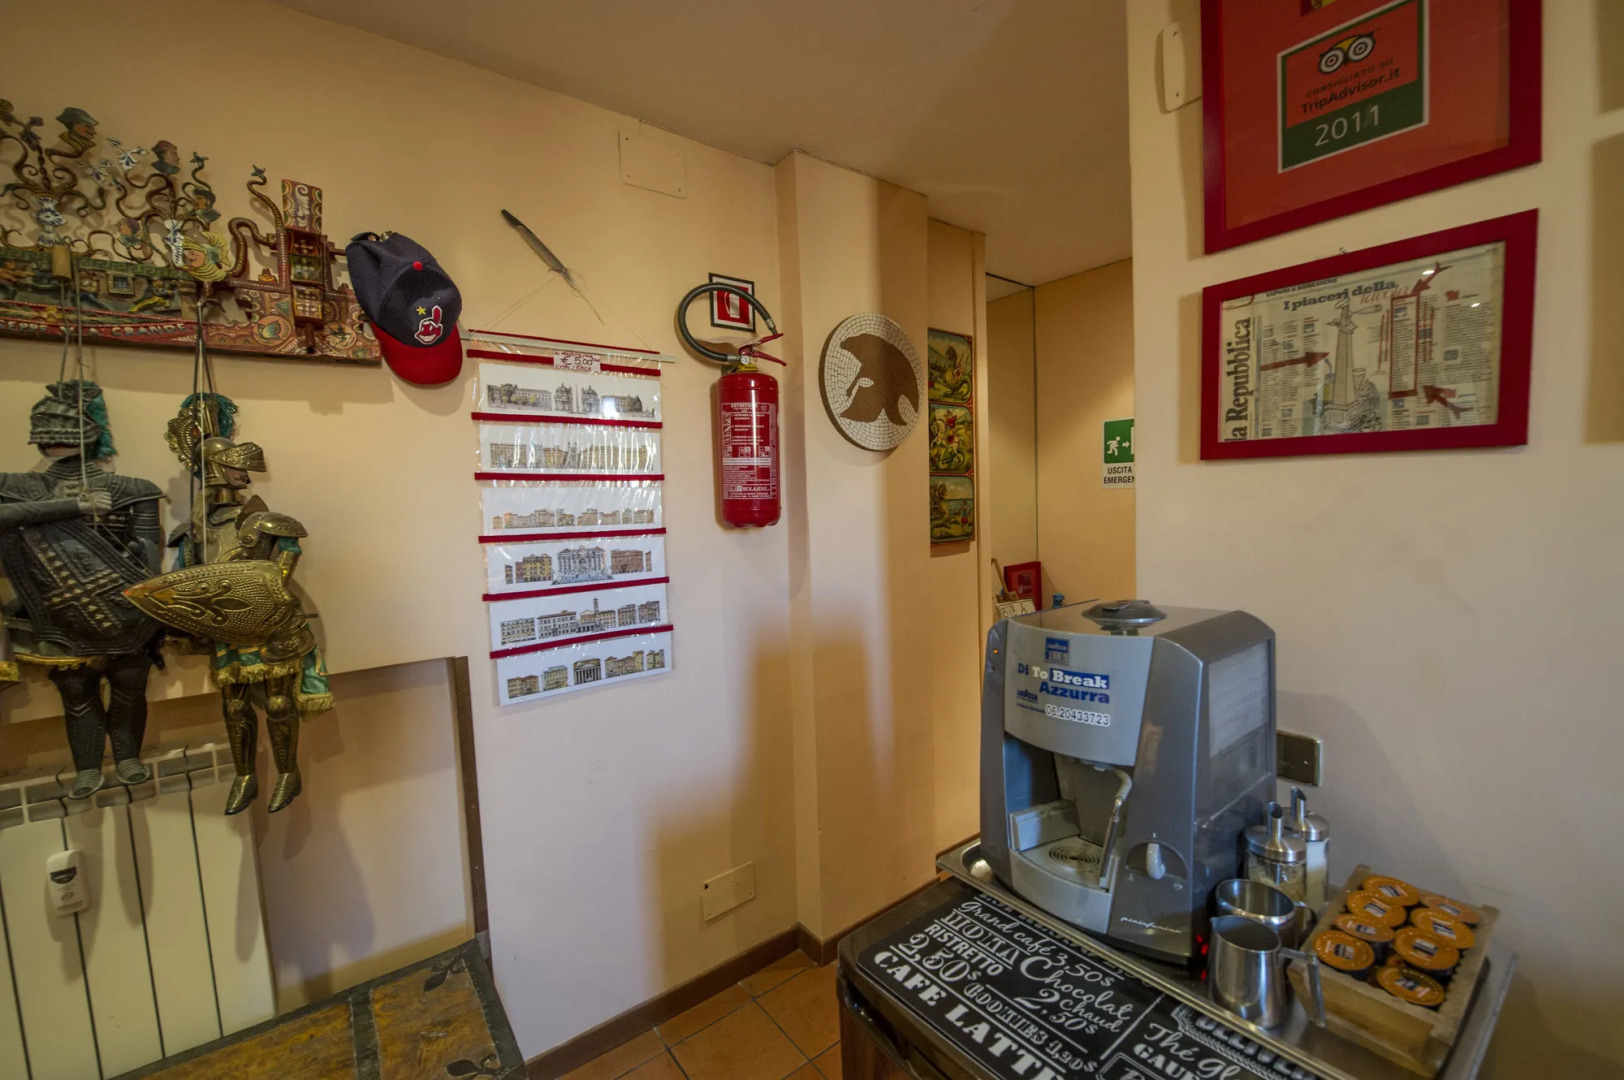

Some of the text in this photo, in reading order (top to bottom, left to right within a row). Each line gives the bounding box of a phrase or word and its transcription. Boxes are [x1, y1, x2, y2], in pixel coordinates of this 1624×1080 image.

[1301, 68, 1400, 114] TripAdvisor.it
[1306, 58, 1394, 98] CONSIGLIATO SU
[1315, 105, 1379, 146] 2011
[1283, 280, 1397, 311] I piaceri della
[111, 324, 186, 337] GRANDE
[1225, 317, 1254, 422] Repubblica
[1107, 466, 1133, 475] USCITA
[1018, 662, 1107, 689] Di To Break
[1039, 681, 1110, 704] Azzurra
[1046, 705, 1109, 725] 06.20433723
[959, 901, 1018, 933] Grand
[1013, 932, 1056, 956] café
[924, 923, 1003, 976] RISTRETTO
[874, 951, 947, 1006] CAFE
[1020, 956, 1133, 1019] Chocolat
[1060, 1000, 1123, 1032] chaud
[1144, 1022, 1199, 1061] Thé
